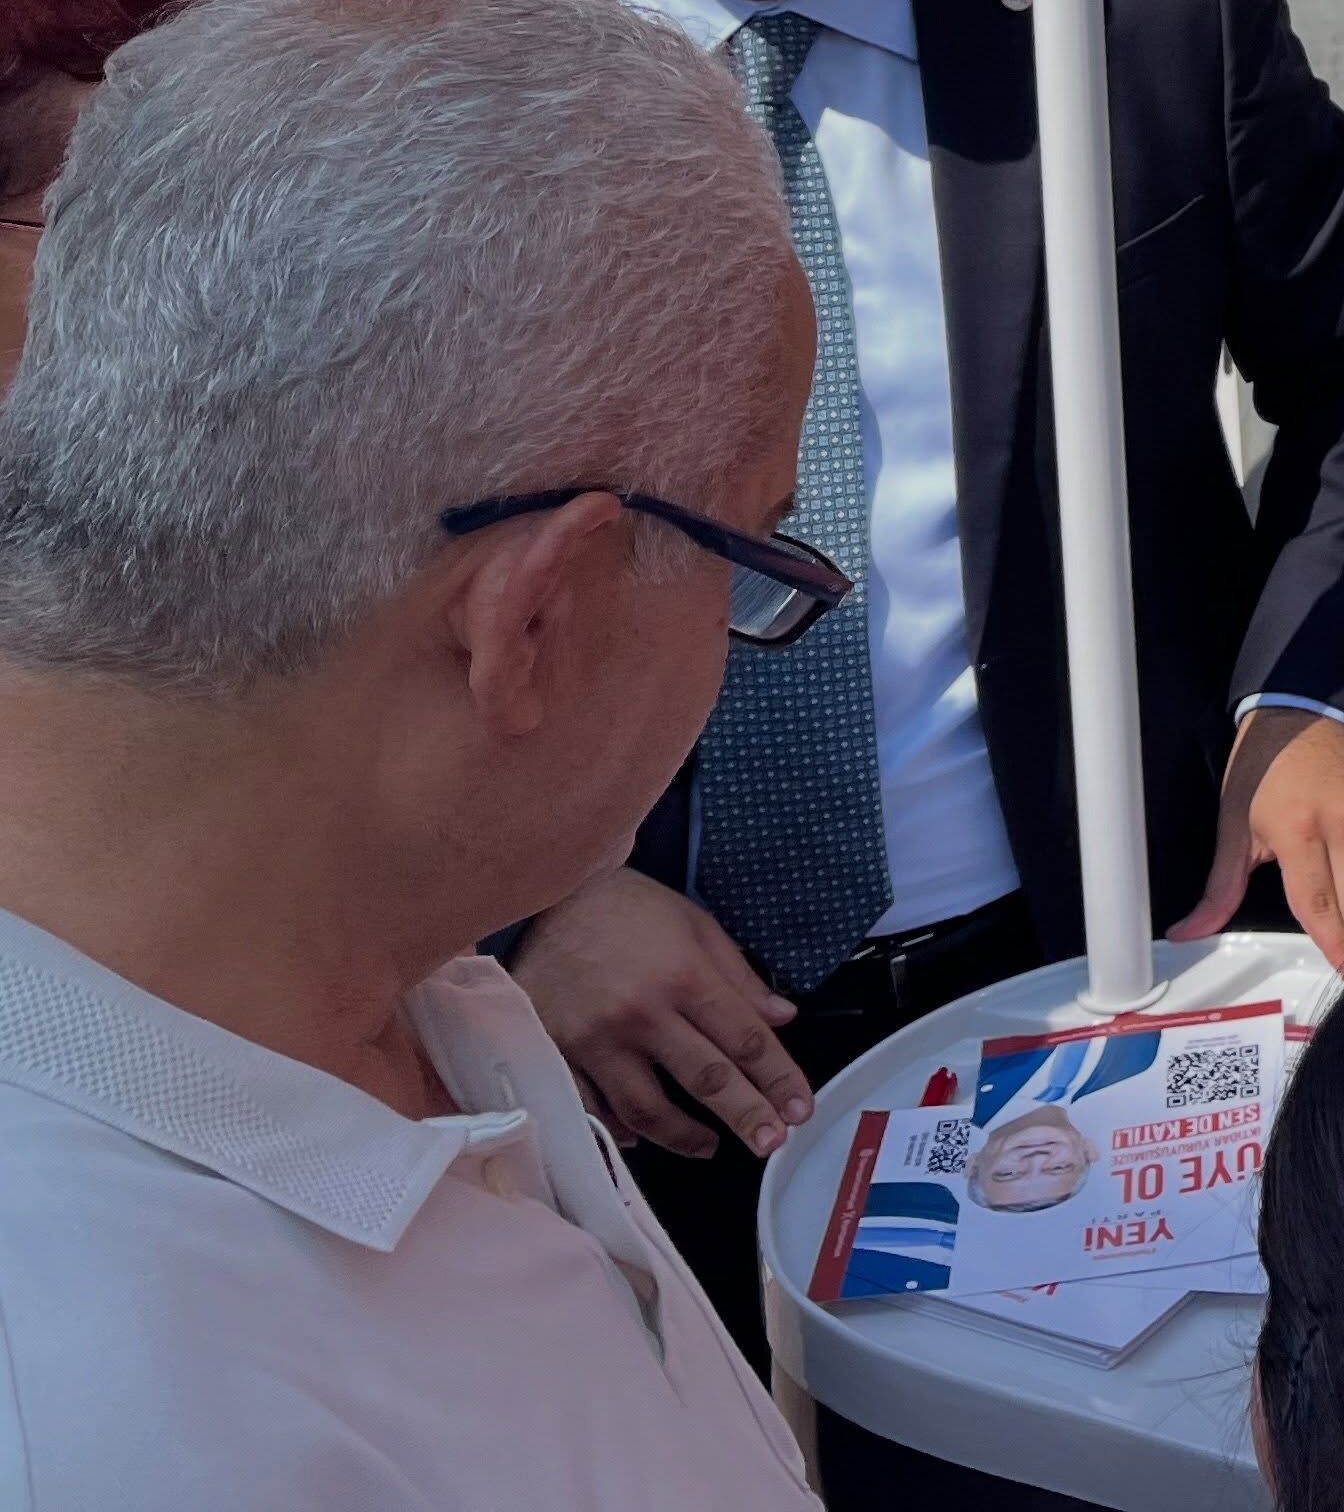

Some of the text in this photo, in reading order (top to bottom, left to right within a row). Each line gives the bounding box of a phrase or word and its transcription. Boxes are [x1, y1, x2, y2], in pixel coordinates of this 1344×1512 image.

[1187, 1115, 1213, 1136] DE
[1218, 1104, 1260, 1128] SEN
[1111, 1164, 1164, 1204] OL
